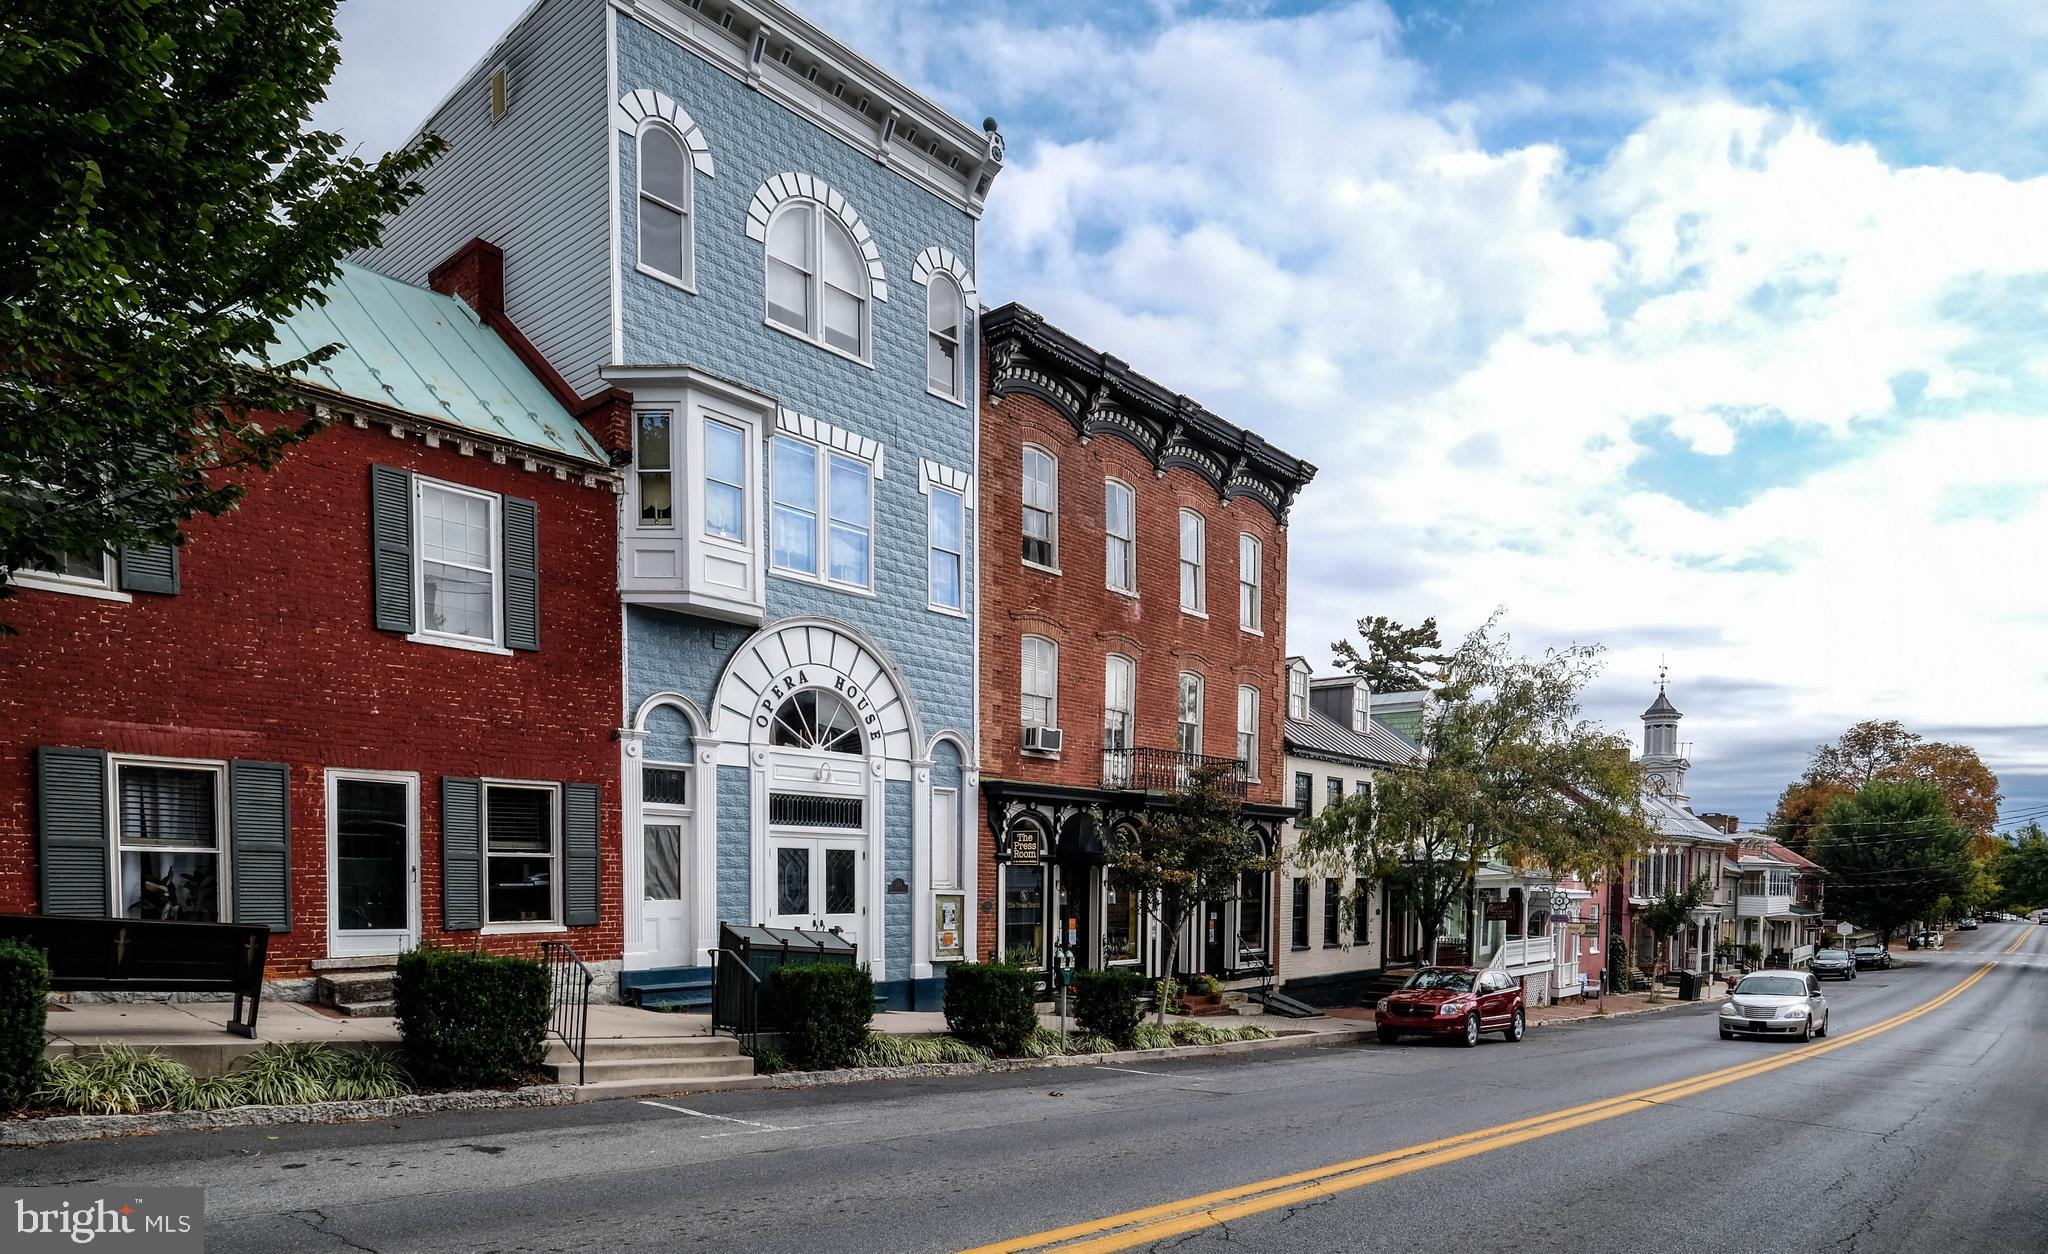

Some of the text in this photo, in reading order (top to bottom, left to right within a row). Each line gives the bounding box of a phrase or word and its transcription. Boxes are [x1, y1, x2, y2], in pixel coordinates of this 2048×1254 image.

[756, 669, 881, 741] OPERA HOUSE
[1016, 833, 1033, 842] The
[1013, 841, 1037, 850] Press
[1013, 850, 1037, 859] Room
